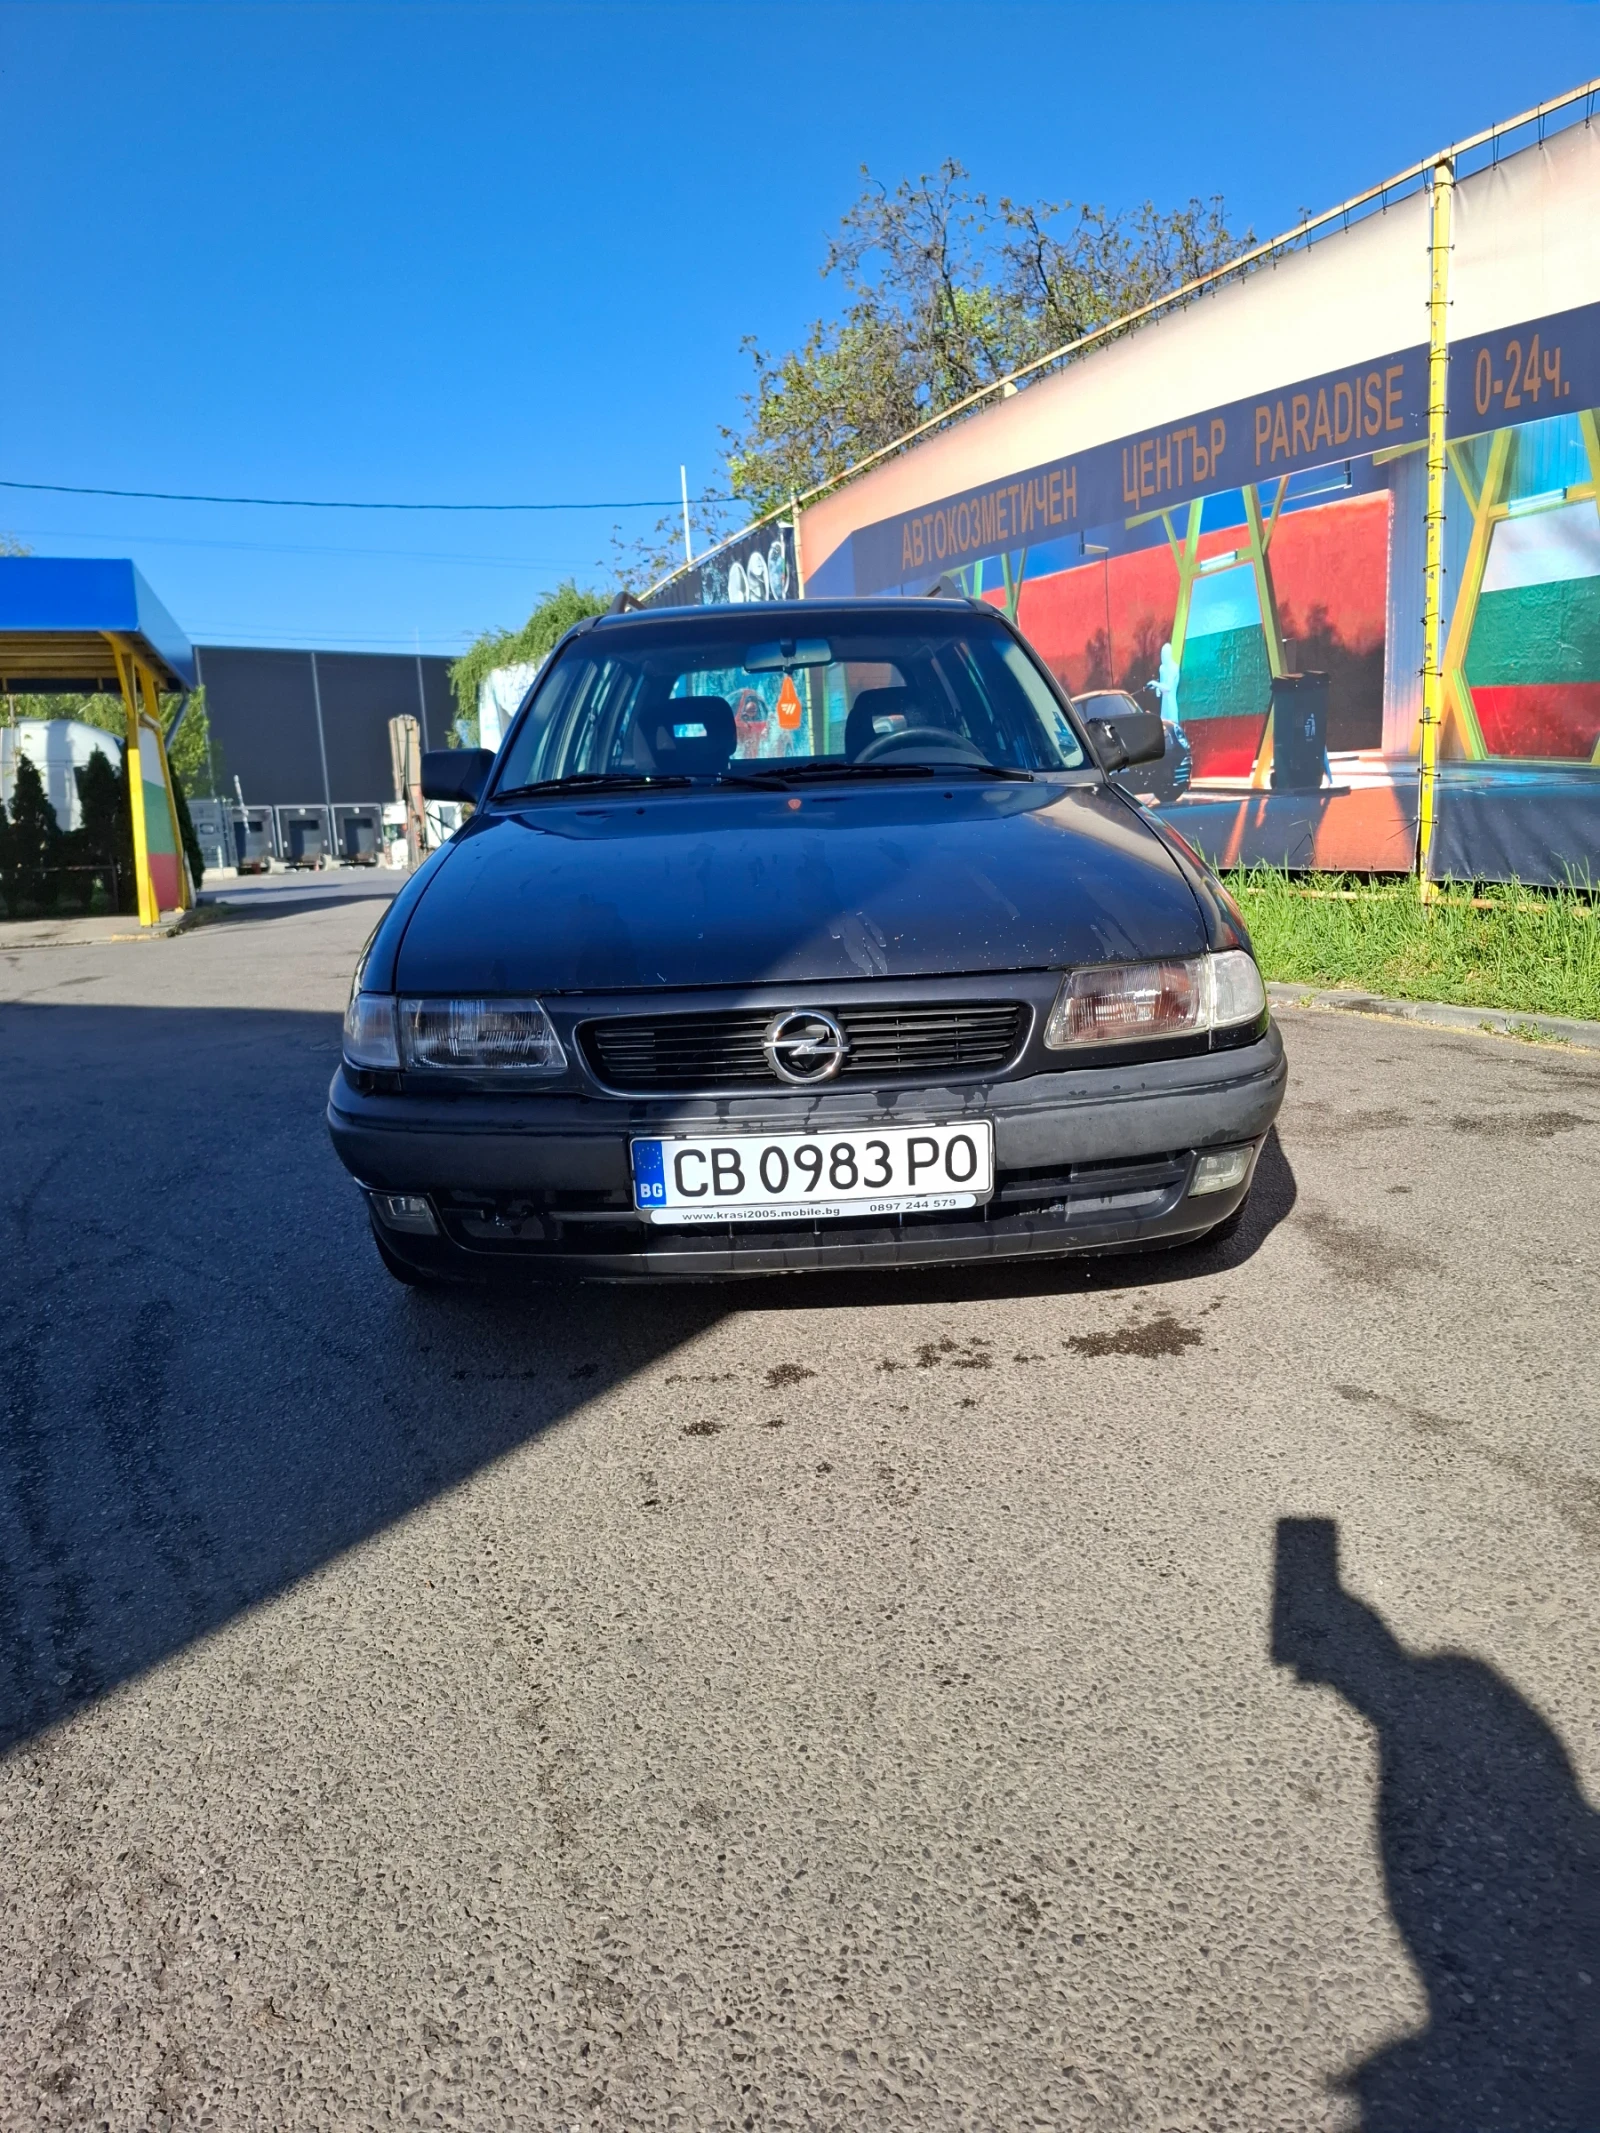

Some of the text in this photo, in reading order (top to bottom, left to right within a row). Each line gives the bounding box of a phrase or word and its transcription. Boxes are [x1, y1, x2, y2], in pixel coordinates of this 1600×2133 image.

[902, 466, 1077, 570] АВТОКОЗМЕТИЧЕН
[1122, 417, 1226, 510] ЦЕНТЪР
[1255, 364, 1404, 466] PARADISE
[674, 1148, 746, 1197] CB
[759, 1139, 893, 1194] 0983
[640, 1183, 663, 1198] BG
[869, 1198, 957, 1212] 0897 244 579
[682, 1207, 841, 1221] www.krasi2005.mobile.bg
